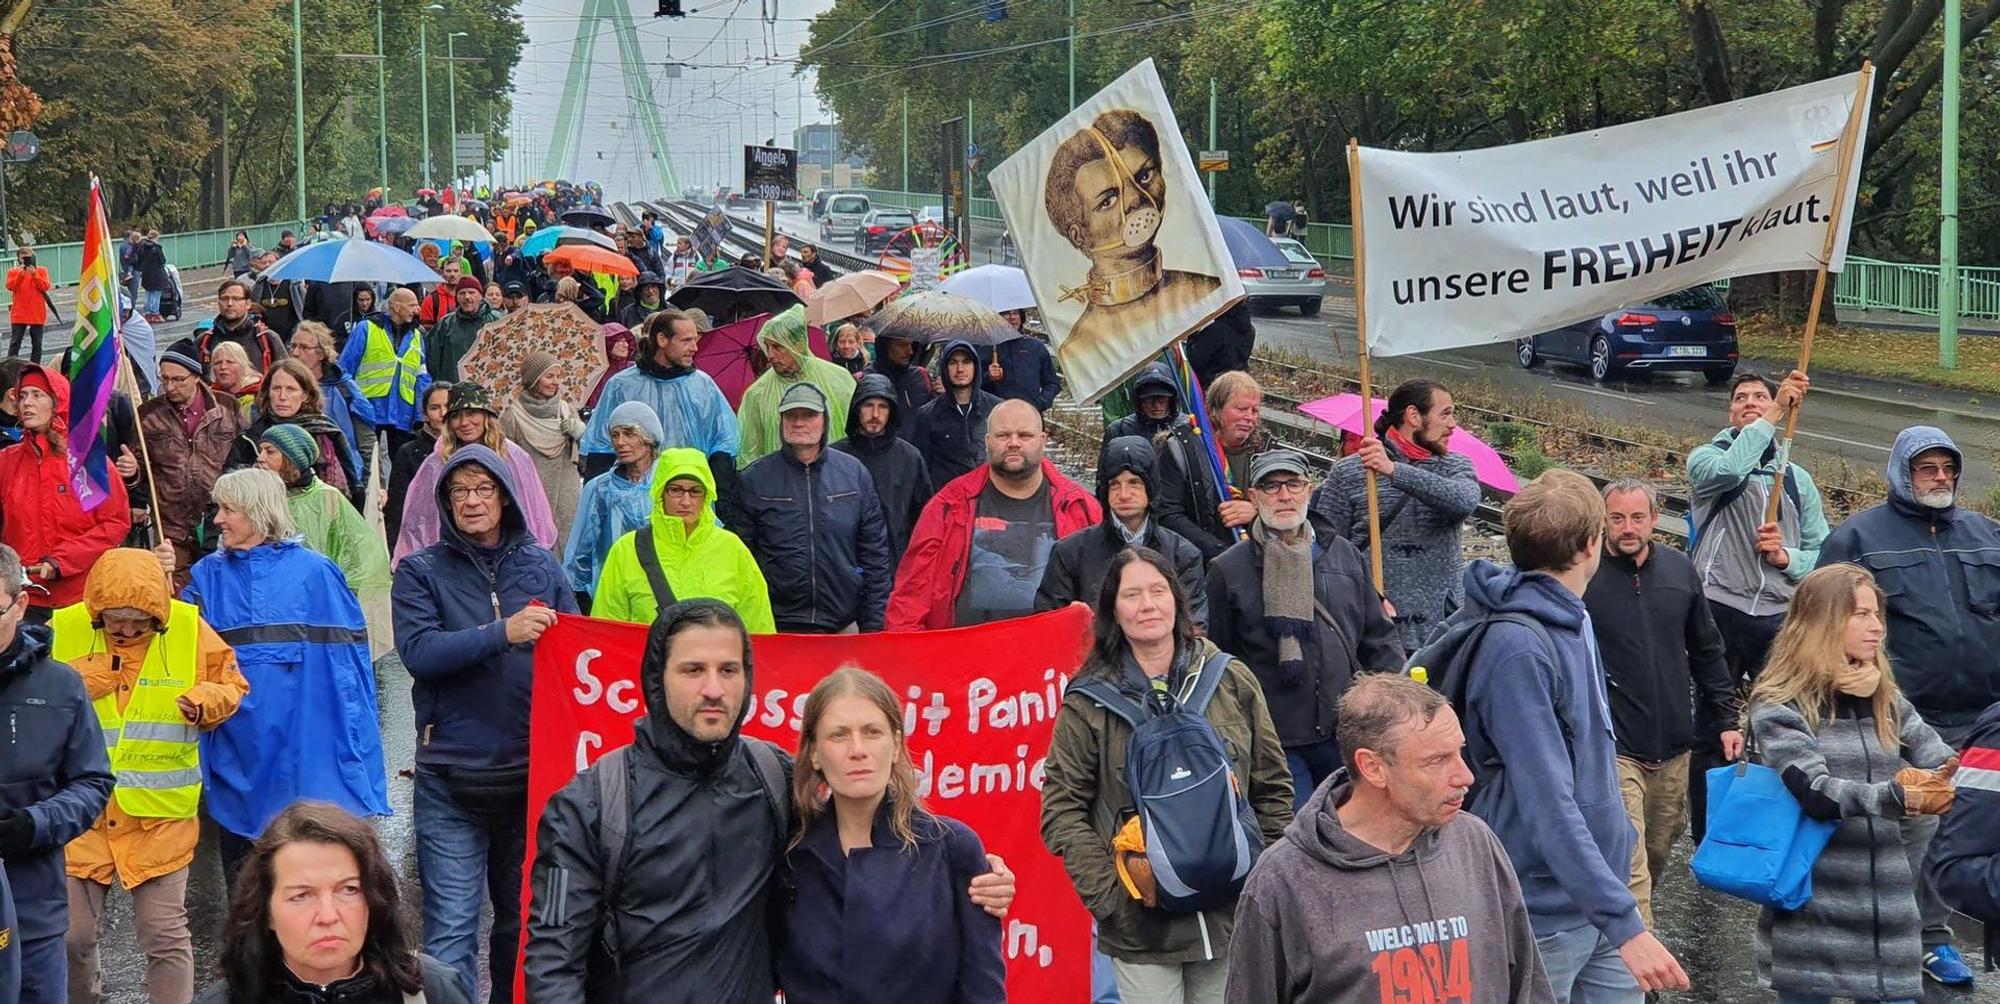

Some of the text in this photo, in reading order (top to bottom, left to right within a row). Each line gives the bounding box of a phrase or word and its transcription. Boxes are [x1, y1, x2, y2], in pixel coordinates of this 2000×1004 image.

[760, 184, 781, 200] 1989
[1388, 149, 1778, 230] Wir sind laut, weil ihr
[1392, 193, 1831, 305] unsere FREIHEIT klaut.
[904, 685, 951, 736] it
[1365, 915, 1468, 952] WELCOME TO
[1371, 937, 1472, 1004] 1984
